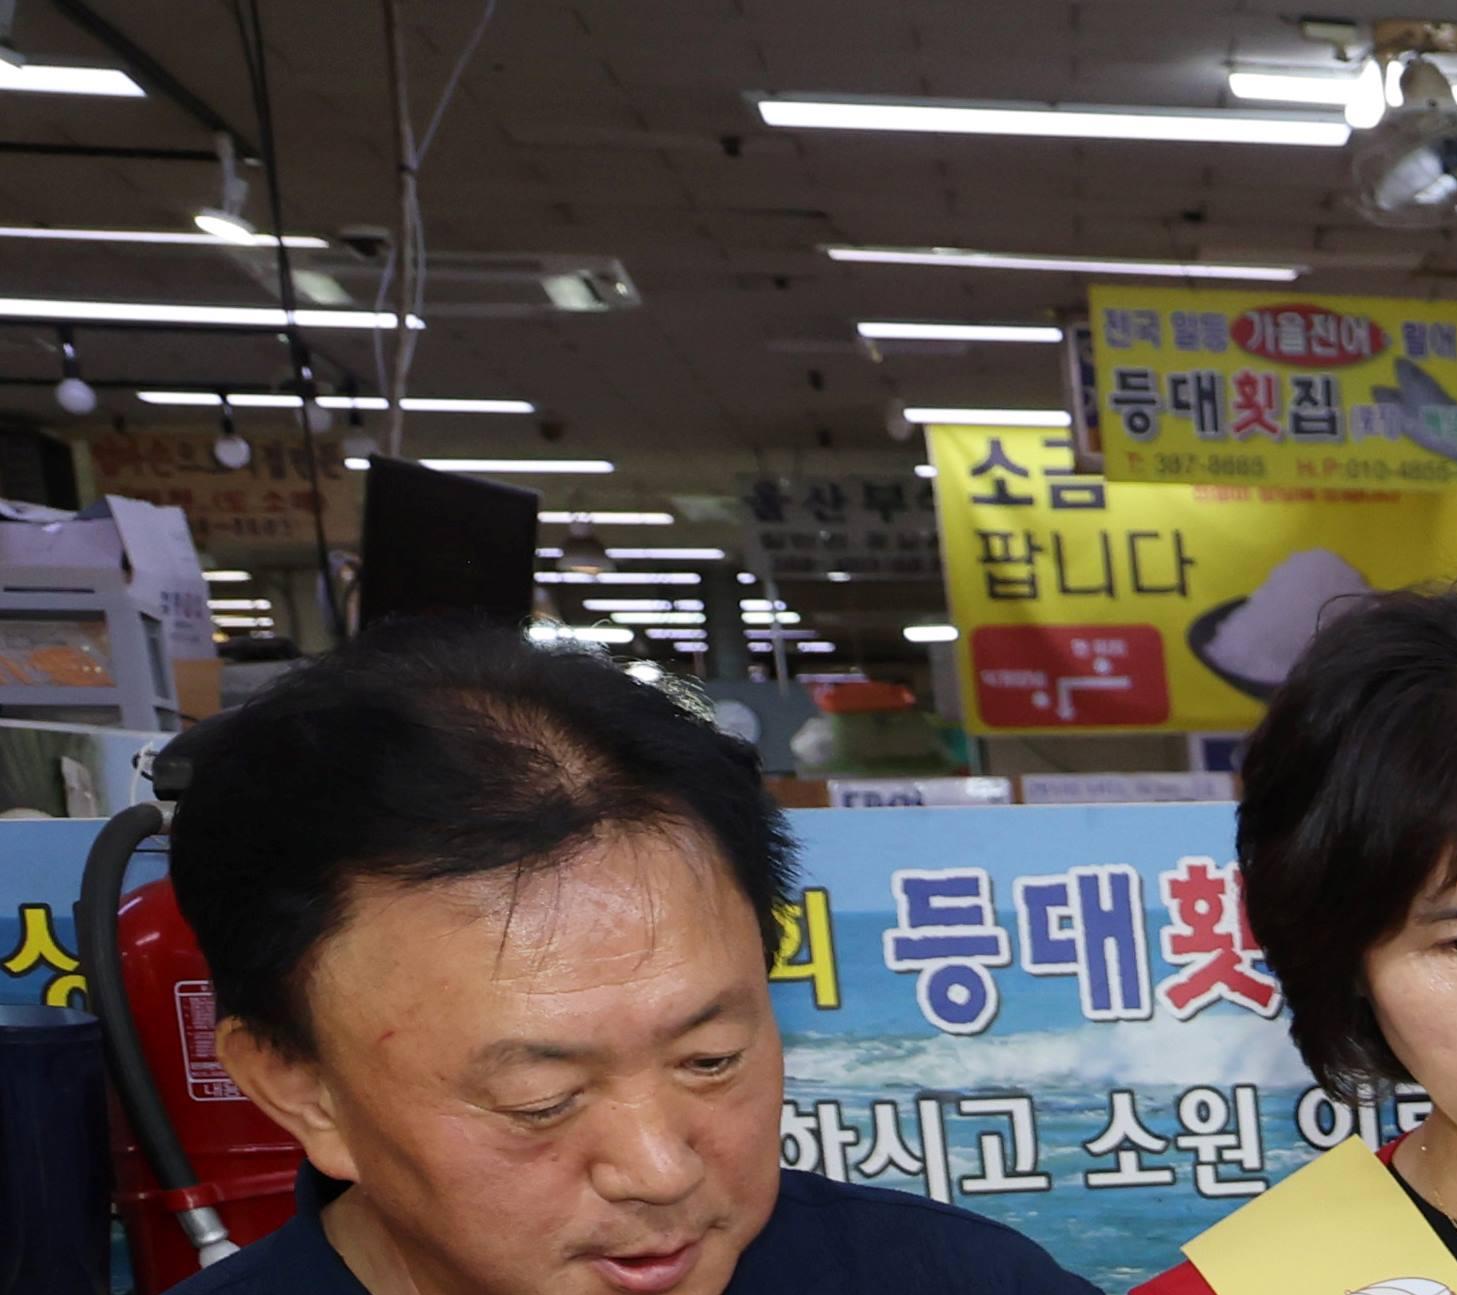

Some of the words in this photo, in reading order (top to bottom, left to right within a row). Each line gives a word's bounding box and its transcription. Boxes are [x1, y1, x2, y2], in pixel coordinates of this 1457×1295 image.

[1242, 309, 1375, 358] 가을전어
[1111, 366, 1345, 441] 등대횟집
[970, 436, 1106, 510] 소금
[975, 530, 1198, 600] 팝니다
[1083, 1083, 1269, 1198] 소원
